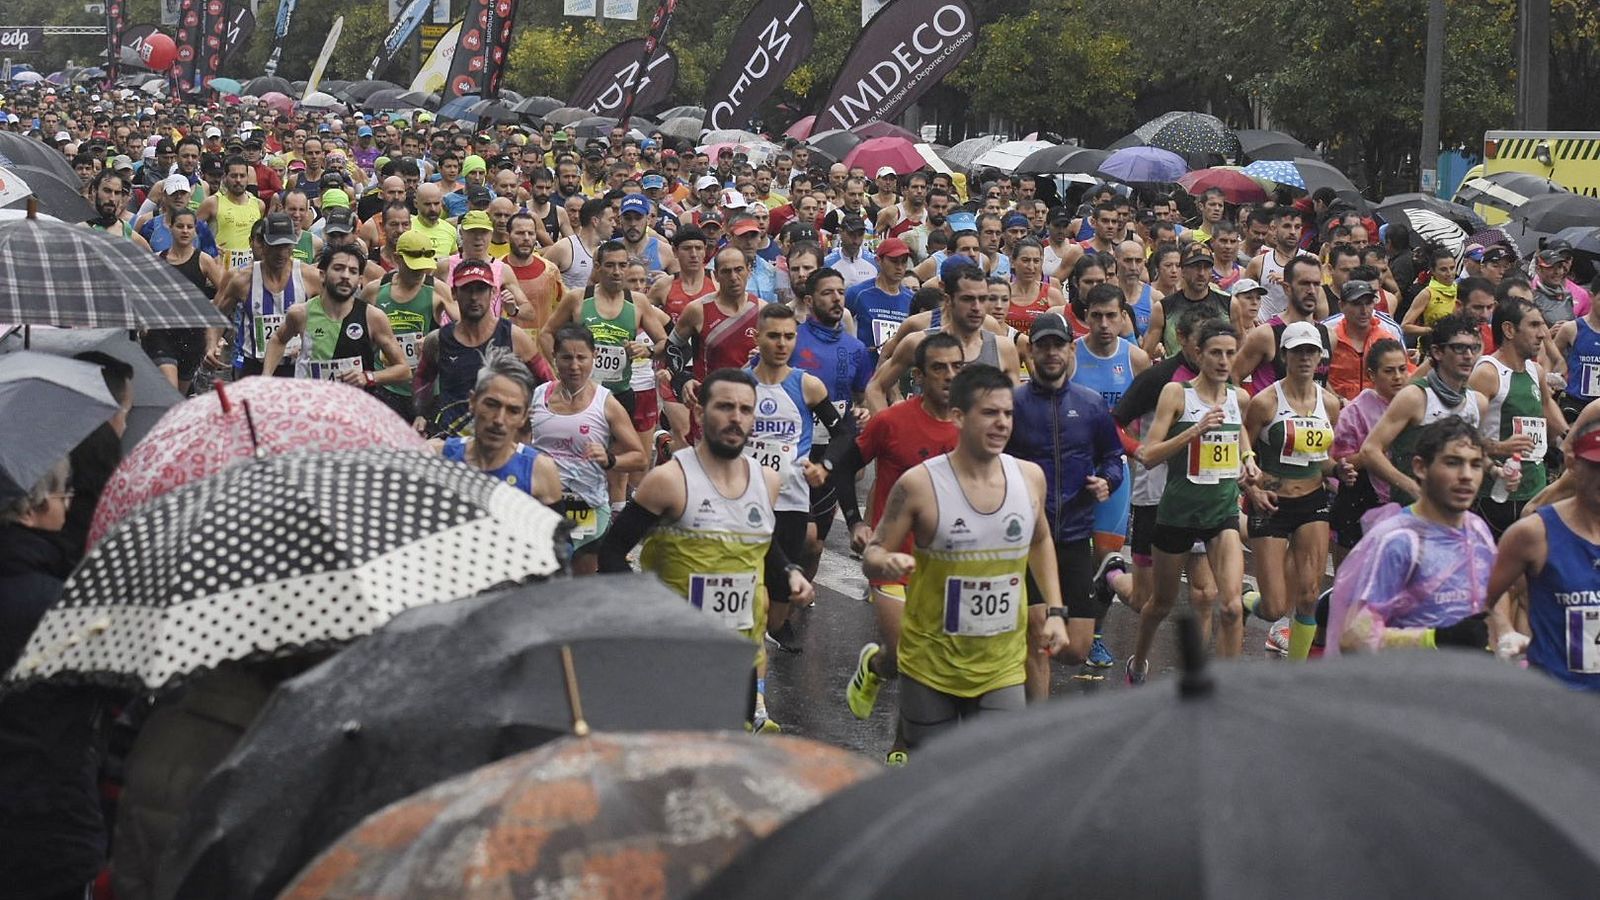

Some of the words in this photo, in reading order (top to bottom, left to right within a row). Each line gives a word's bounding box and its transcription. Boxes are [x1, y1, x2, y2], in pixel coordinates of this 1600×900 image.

[1, 29, 29, 49] edp
[828, 4, 966, 131] IMDECO
[876, 87, 909, 117] Municipal
[908, 79, 916, 89] de
[915, 54, 946, 81] Deportes
[944, 31, 973, 56] Córdoba
[595, 355, 620, 370] 309
[751, 421, 796, 435] BRIJA
[1306, 430, 1323, 447] 82
[1213, 445, 1229, 462] 81
[970, 592, 1010, 616] 305
